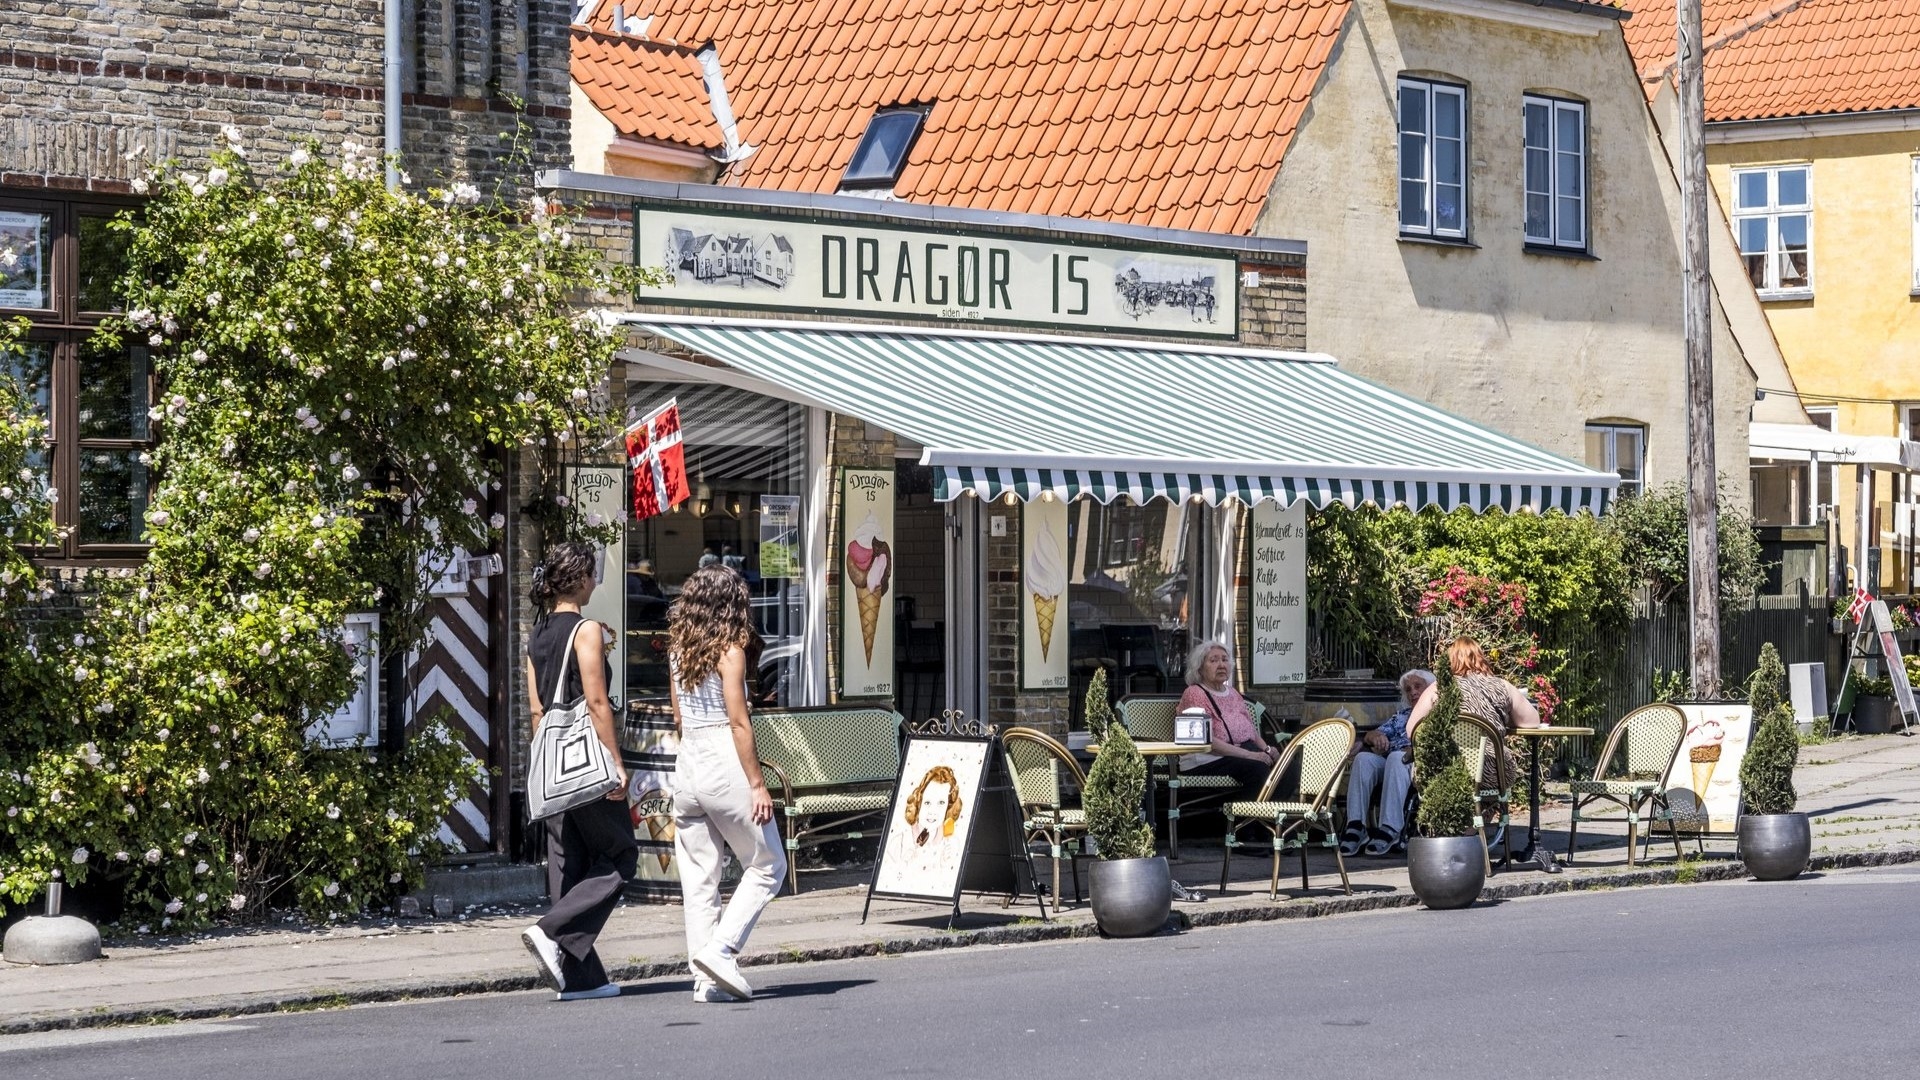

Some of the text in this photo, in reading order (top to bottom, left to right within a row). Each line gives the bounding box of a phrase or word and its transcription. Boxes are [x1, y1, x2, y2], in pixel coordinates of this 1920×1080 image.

[822, 234, 1089, 315] DRAGØR IS
[942, 307, 980, 319] siden 1927
[1255, 546, 1286, 563] Softice
[1255, 567, 1278, 586] Kaffe
[1255, 590, 1300, 610] Milkshakes
[1291, 672, 1304, 682] 1927
[876, 683, 891, 693] 1927
